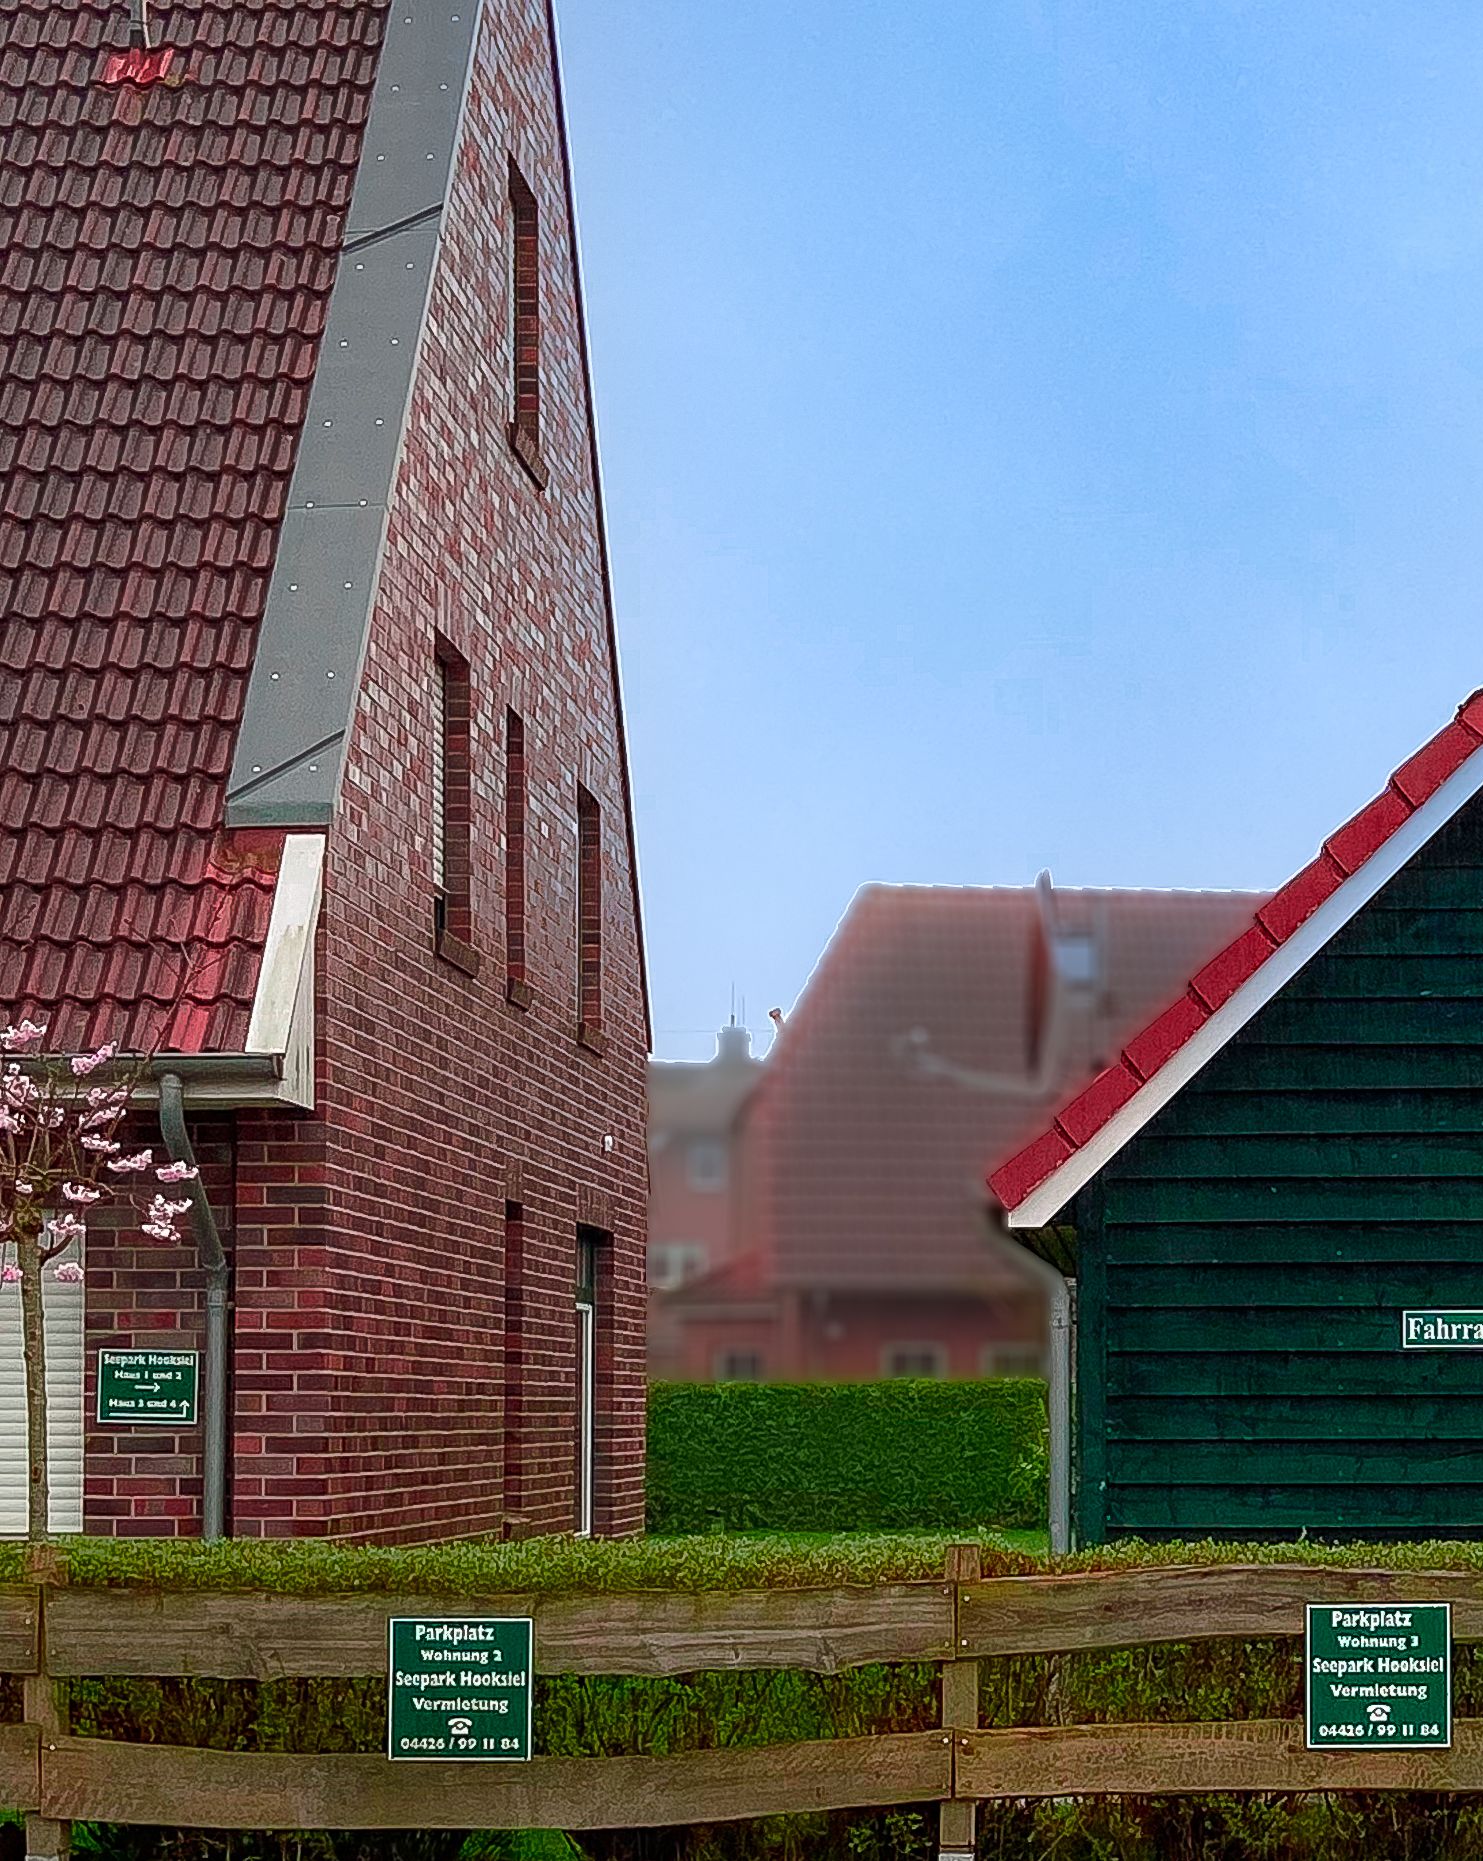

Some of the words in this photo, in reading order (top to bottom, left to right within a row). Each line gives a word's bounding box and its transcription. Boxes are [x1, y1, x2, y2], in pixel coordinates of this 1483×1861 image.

[104, 1354, 146, 1367] Seepark
[149, 1355, 193, 1366] Hooksiel
[144, 1370, 148, 1379] 1
[175, 1371, 182, 1380] 2
[137, 1399, 144, 1407] 3
[169, 1399, 176, 1408] 4
[1332, 1611, 1412, 1631] Parkplatz
[416, 1625, 494, 1645] Parkplatz
[1337, 1636, 1407, 1650] Wohnung
[1411, 1636, 1419, 1647] 3
[421, 1650, 488, 1664] Wohnung
[493, 1650, 502, 1661] 2
[1313, 1657, 1374, 1677] Seepark
[1378, 1657, 1443, 1673] Hooksiel
[396, 1671, 456, 1691] Seepark
[460, 1671, 525, 1686] Hooksiel
[1330, 1683, 1427, 1699] Vermietung
[412, 1697, 509, 1713] Vermietung
[1319, 1724, 1364, 1737] 04426
[1377, 1724, 1396, 1736] 99
[1402, 1724, 1414, 1736] 11
[1420, 1724, 1439, 1736] 84
[400, 1738, 445, 1749] 04426
[457, 1738, 476, 1749] 99
[483, 1738, 495, 1749] 11
[501, 1738, 519, 1749] 84
